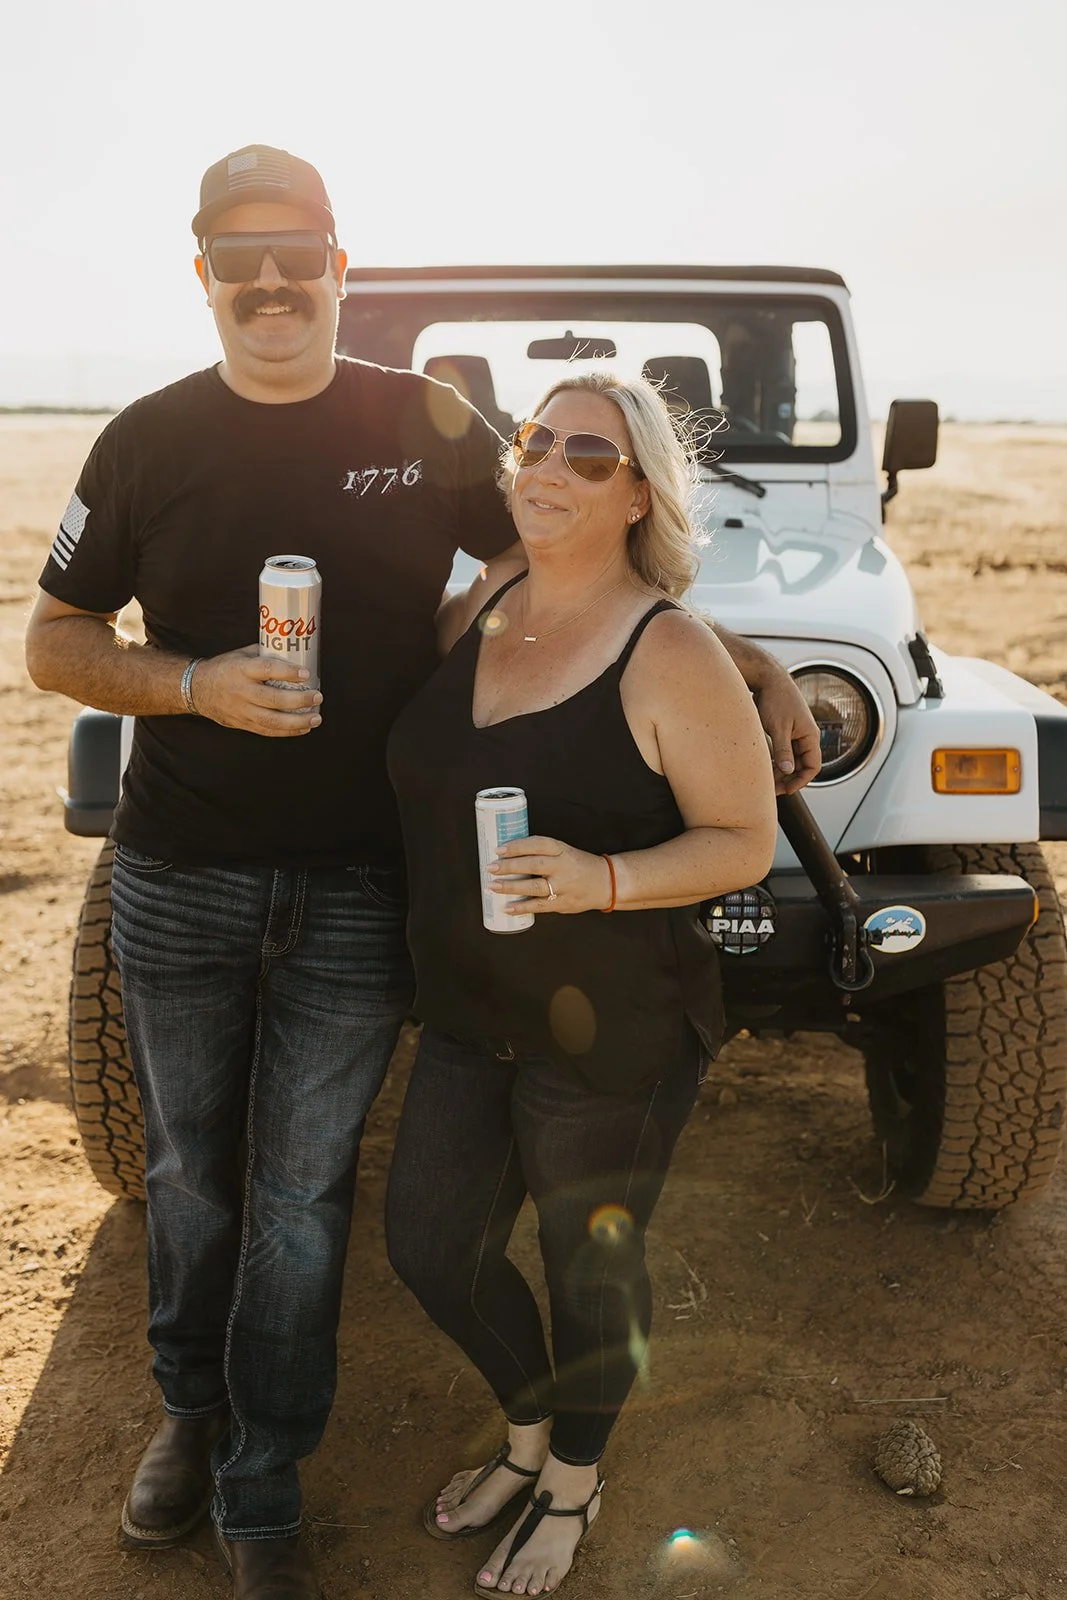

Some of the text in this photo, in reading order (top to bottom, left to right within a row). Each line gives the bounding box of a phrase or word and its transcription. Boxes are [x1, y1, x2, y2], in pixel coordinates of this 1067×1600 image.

[342, 459, 423, 496] 1776
[259, 605, 317, 637] Coors
[712, 919, 775, 933] PIAA
